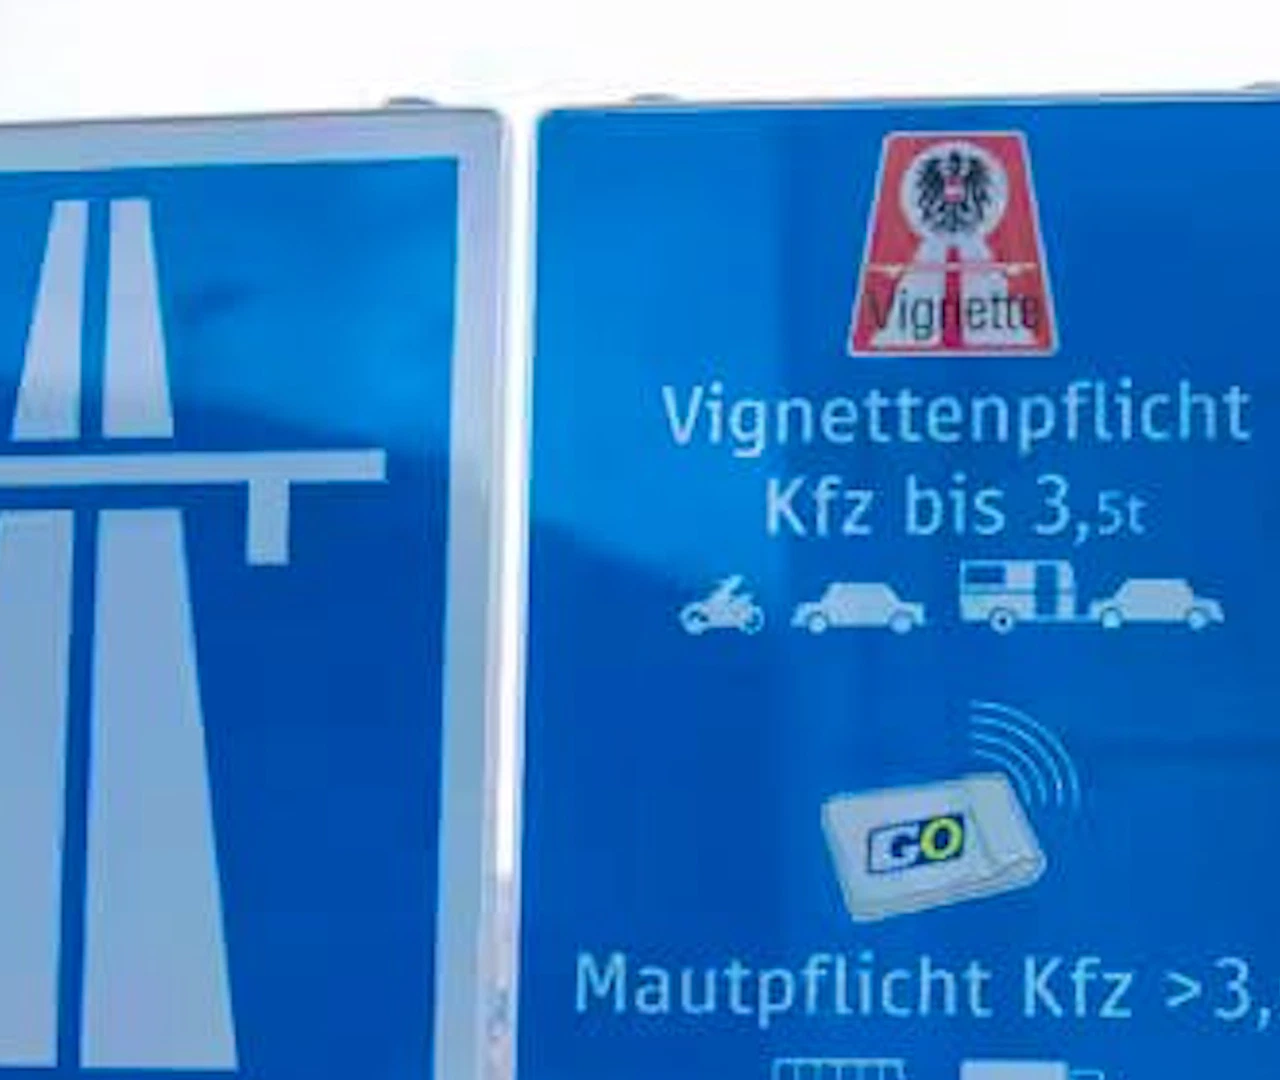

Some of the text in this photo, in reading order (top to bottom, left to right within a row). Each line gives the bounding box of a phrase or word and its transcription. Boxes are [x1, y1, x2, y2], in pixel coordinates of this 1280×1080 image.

[861, 286, 1041, 341] Vignette
[662, 378, 1252, 458] Vignettenpflicht
[765, 472, 1147, 546] Kfz bis 3,5t
[877, 816, 964, 870] GO
[574, 951, 992, 1030] Mautpflicht
[1023, 956, 1133, 1020] Kfz
